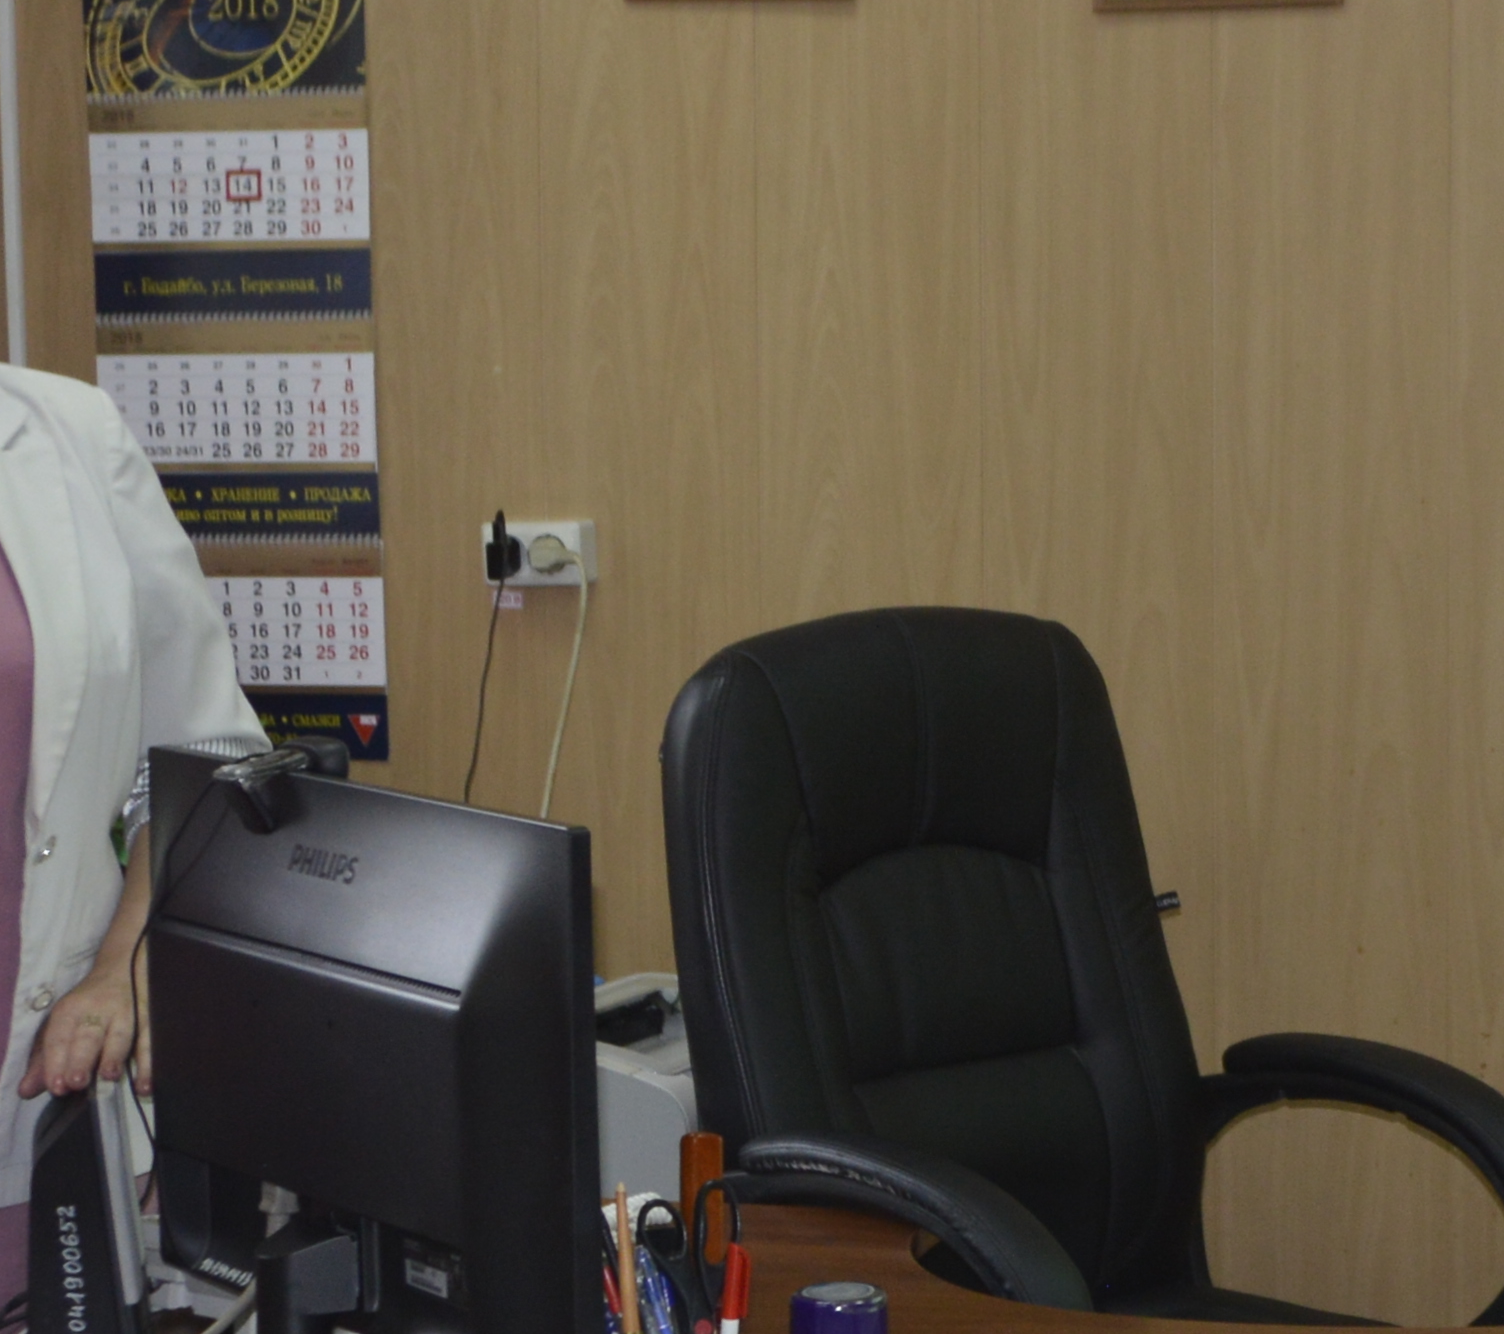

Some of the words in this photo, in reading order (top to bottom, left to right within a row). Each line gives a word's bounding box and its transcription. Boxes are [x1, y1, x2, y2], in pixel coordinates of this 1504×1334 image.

[137, 221, 157, 238] 25
[169, 221, 189, 237] 26
[202, 220, 222, 237] 27
[233, 220, 253, 236] 28
[267, 220, 287, 236] 29
[301, 220, 322, 235] 30
[211, 486, 280, 503] ХРАНЕНИЕ
[304, 485, 371, 503] ПРОДАЖА
[223, 581, 230, 596] 1
[253, 580, 263, 597] 2
[286, 580, 296, 597] 3
[320, 581, 329, 596] 4
[353, 581, 363, 597] 5
[253, 601, 264, 618] 9
[283, 602, 302, 618] 10
[317, 602, 333, 617] 11
[350, 602, 369, 618] 12
[250, 622, 269, 639] 16
[283, 623, 302, 638] 17
[317, 623, 336, 639] 18
[350, 623, 369, 639] 19
[250, 644, 270, 660] 23
[282, 644, 302, 660] 24
[316, 644, 337, 660] 25
[349, 644, 370, 661] 26
[250, 665, 271, 681] 30
[283, 665, 301, 681] 31
[289, 844, 359, 885] PHILIPS
